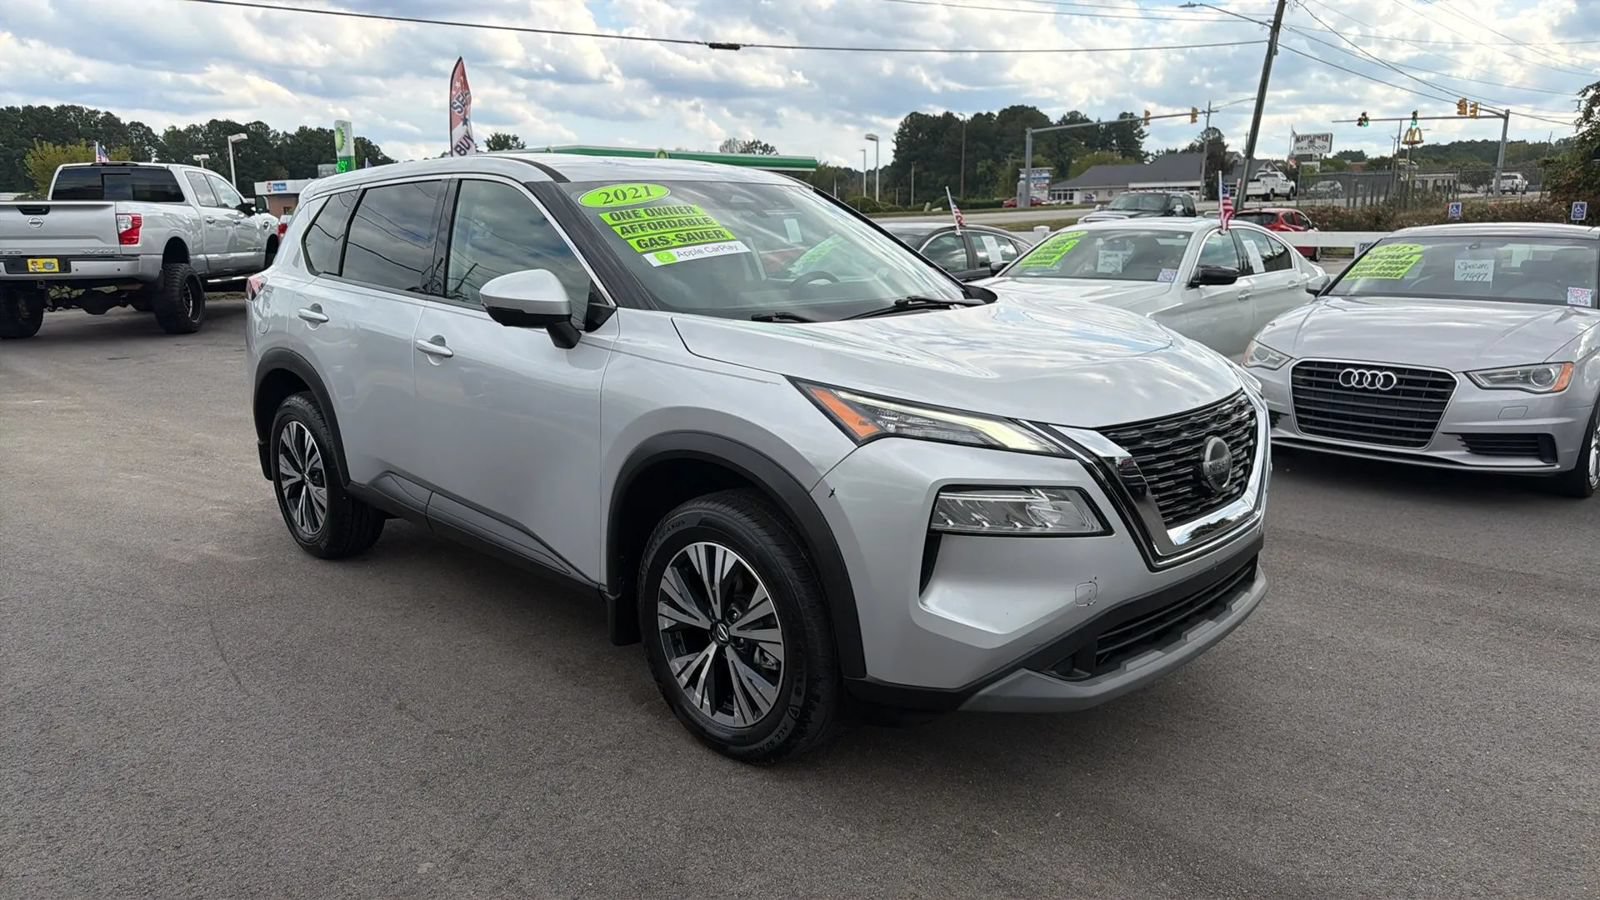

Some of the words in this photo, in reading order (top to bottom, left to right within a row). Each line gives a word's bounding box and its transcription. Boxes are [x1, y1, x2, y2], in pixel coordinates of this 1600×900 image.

[454, 132, 474, 156] BUY
[598, 185, 652, 204] 2021
[609, 210, 642, 221] ONE
[643, 205, 696, 218] OWNER
[621, 217, 714, 235] AFFORDABLE
[636, 229, 725, 249] GAS-SAVER
